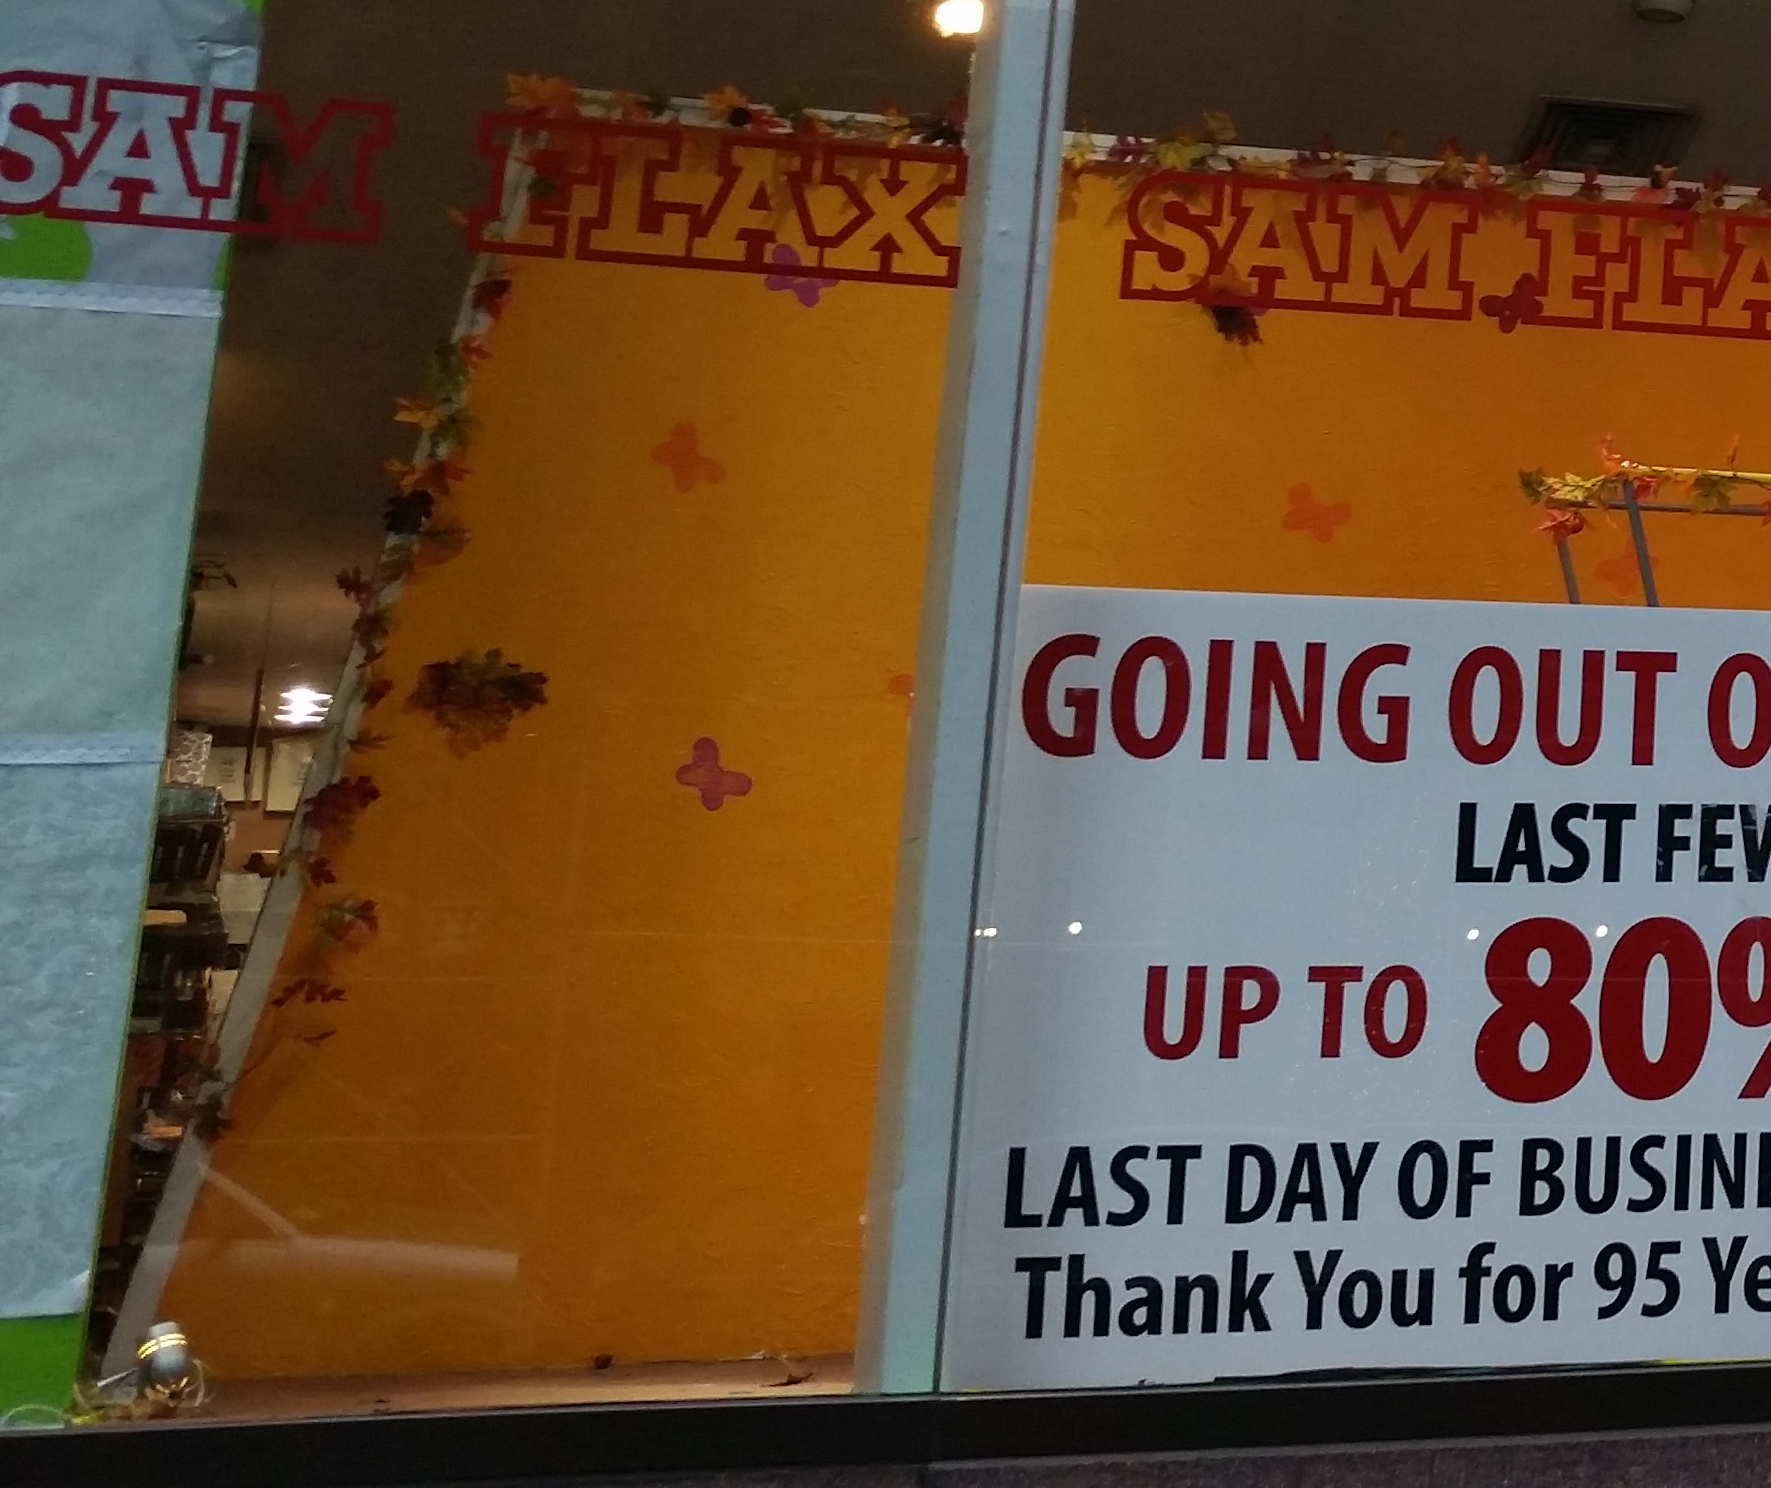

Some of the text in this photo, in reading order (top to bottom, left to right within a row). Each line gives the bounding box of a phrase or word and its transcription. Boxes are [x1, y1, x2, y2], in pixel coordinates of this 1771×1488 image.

[0, 69, 968, 289] SAM FLAX
[1120, 170, 1479, 322] SAM
[1022, 632, 1411, 764] GOING
[1448, 645, 1679, 767] OUT
[1455, 801, 1637, 884] LAST
[1143, 964, 1281, 1061] UP
[1307, 964, 1429, 1060] TO
[1003, 1143, 1202, 1230] LAST
[1223, 1140, 1380, 1225] DAY
[1397, 1137, 1495, 1220] OF
[1014, 1249, 1275, 1341] Thank
[1293, 1248, 1436, 1332] You
[1458, 1242, 1575, 1326] for
[1593, 1240, 1682, 1320] 95
